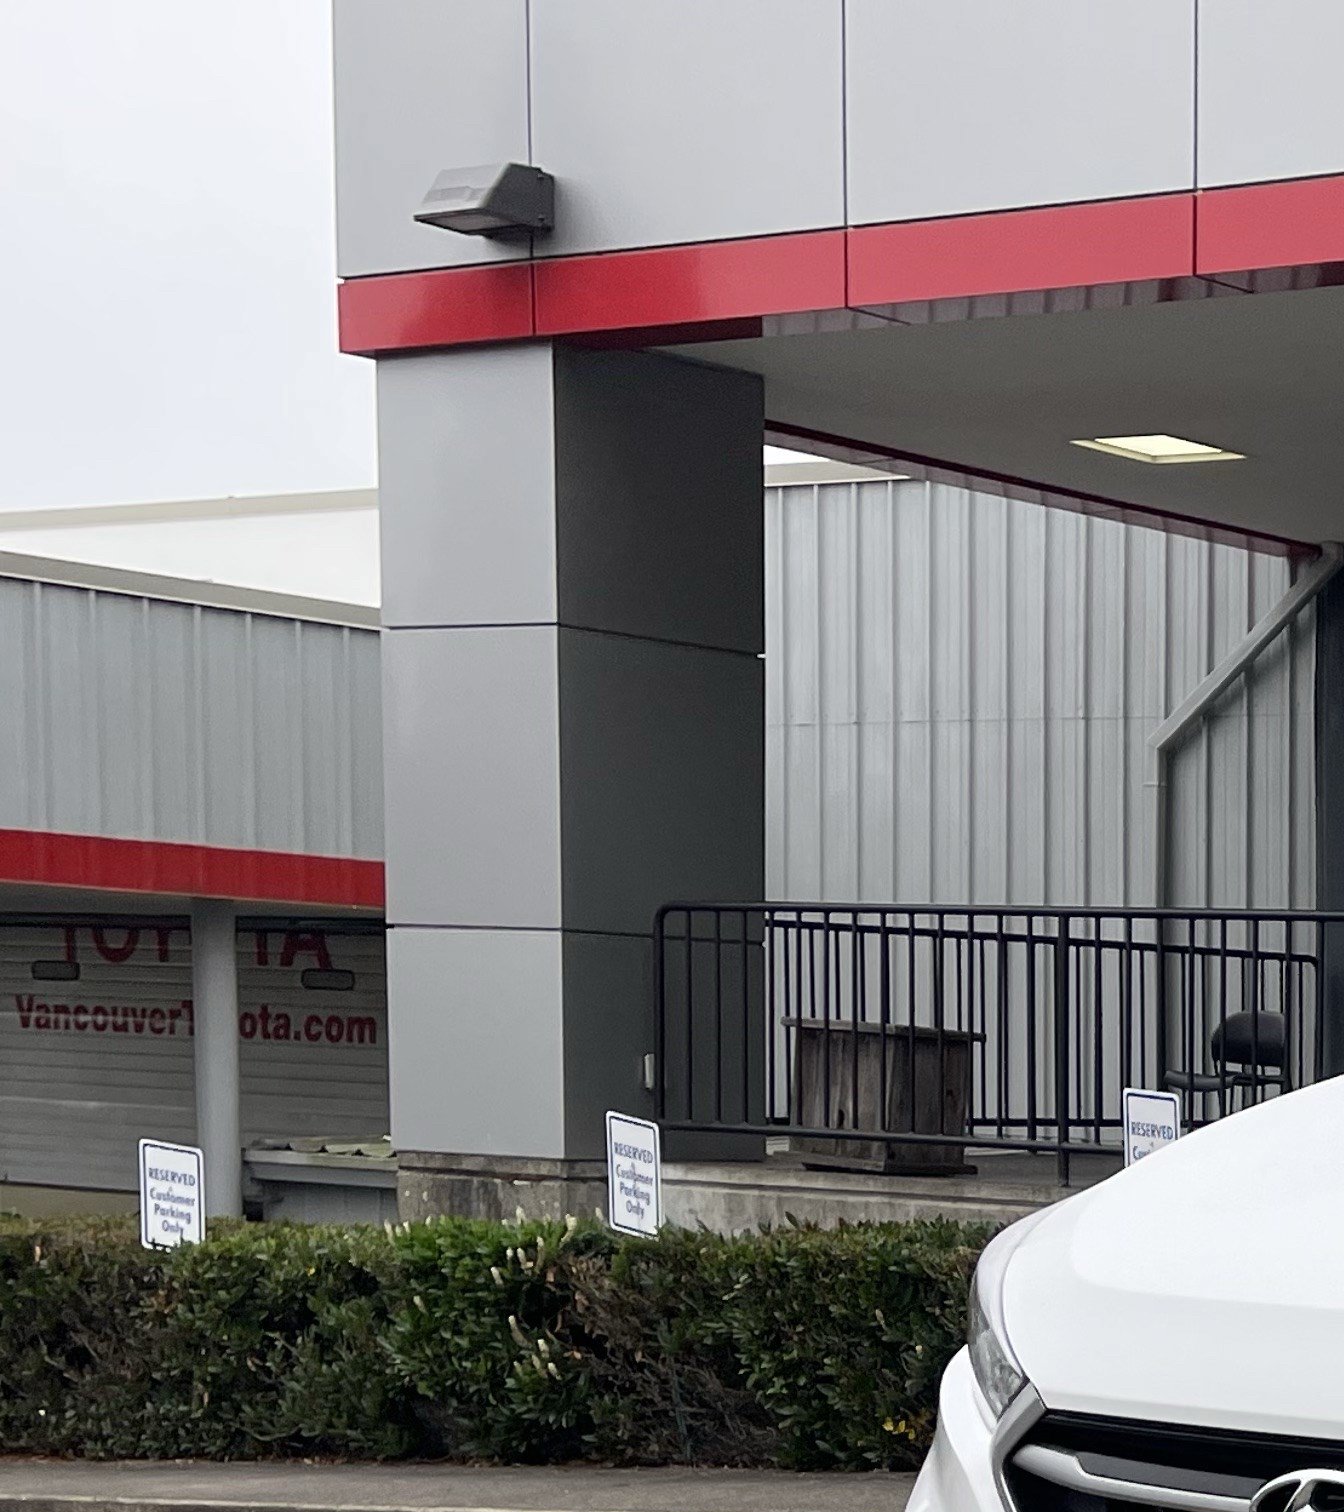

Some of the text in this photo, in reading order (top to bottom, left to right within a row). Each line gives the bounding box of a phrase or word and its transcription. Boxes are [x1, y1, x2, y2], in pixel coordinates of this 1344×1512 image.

[1131, 1121, 1174, 1140] RESERVED
[614, 1141, 654, 1164] RESERVED
[148, 1167, 196, 1187] RESERVED
[616, 1163, 654, 1186] Customer
[149, 1186, 196, 1207] Customer
[619, 1181, 651, 1206] Parking
[154, 1203, 192, 1225] Parking
[625, 1200, 645, 1220] Only
[162, 1219, 184, 1237] Only
